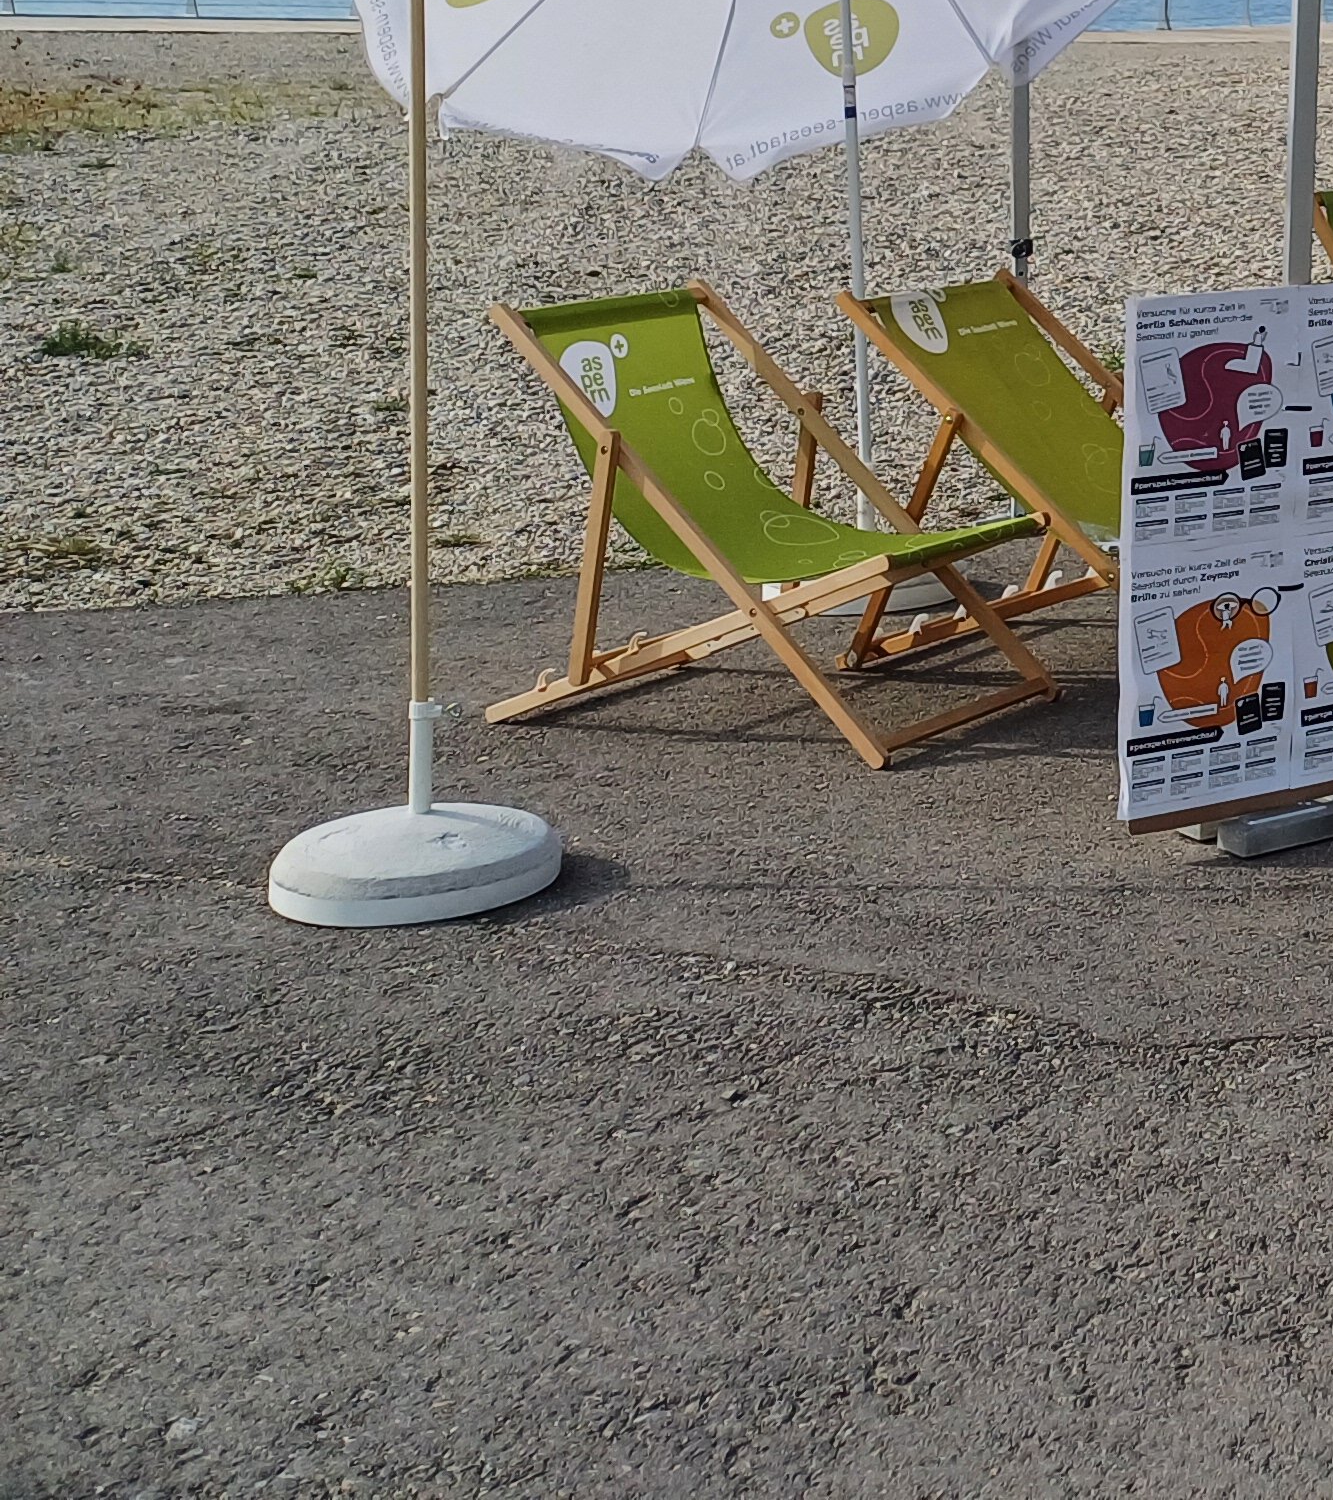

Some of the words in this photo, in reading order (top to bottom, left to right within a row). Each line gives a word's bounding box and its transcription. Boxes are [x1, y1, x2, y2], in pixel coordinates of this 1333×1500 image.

[912, 313, 934, 332] pe
[581, 356, 603, 372] as
[580, 372, 604, 394] pe
